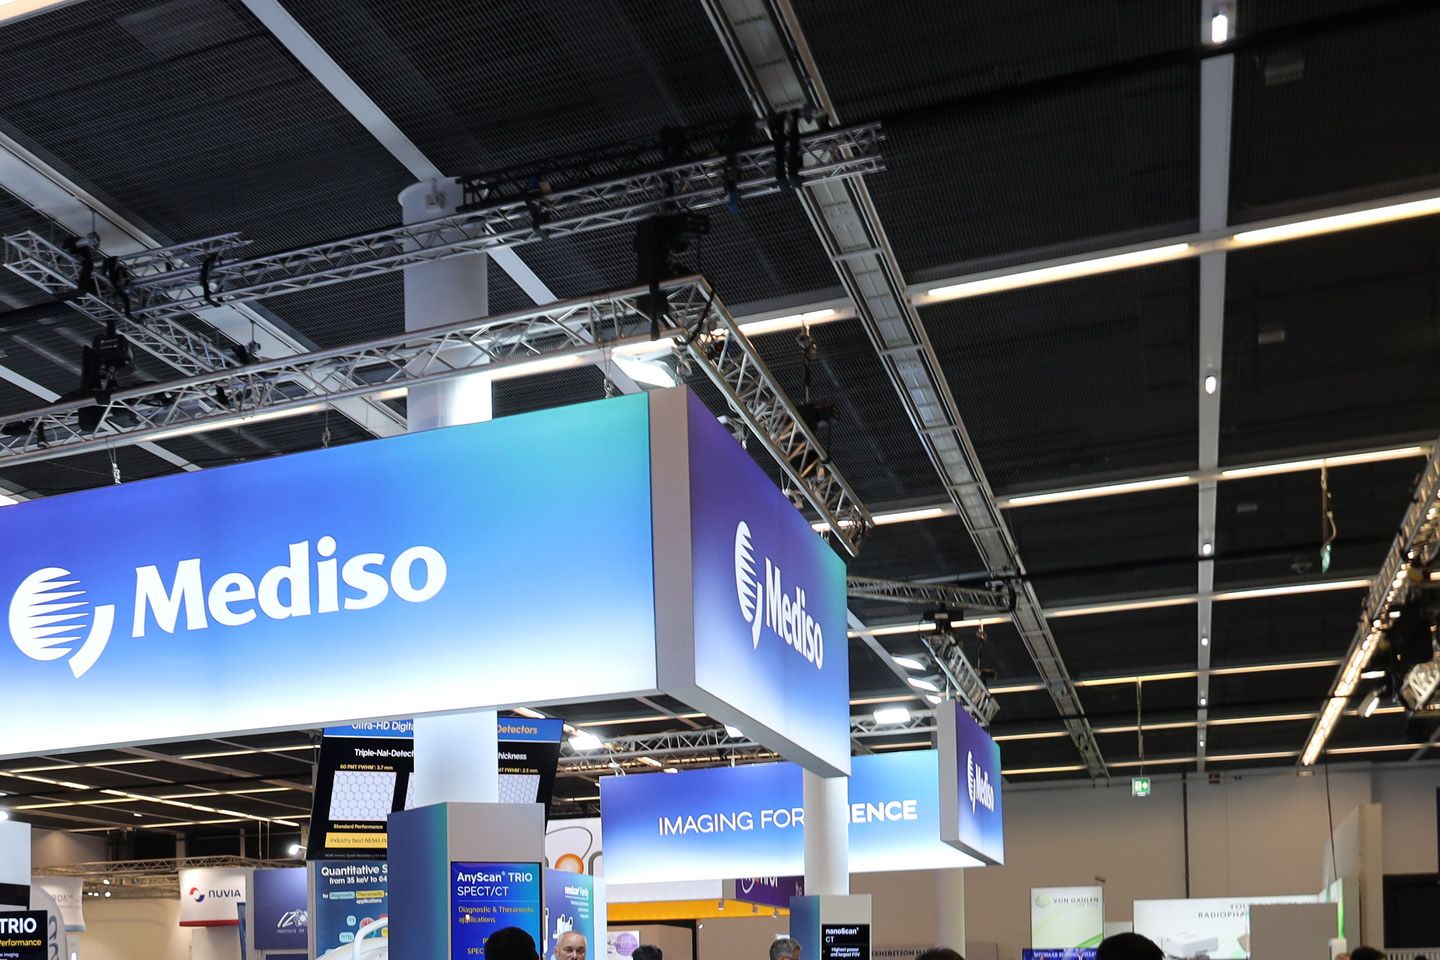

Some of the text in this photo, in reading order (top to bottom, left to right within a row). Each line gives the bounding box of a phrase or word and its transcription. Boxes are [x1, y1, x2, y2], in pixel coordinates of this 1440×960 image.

[131, 535, 448, 640] Mediso
[765, 556, 824, 671] Mediso
[975, 763, 995, 813] Mediso
[658, 799, 918, 837] IMAGING FOR IENCE
[321, 865, 380, 877] Quantitative
[329, 877, 345, 885] from
[508, 872, 533, 882] TRIO
[457, 886, 509, 896] SPECT/CT
[1053, 896, 1069, 904] VON
[458, 906, 491, 914] Diagnostic
[458, 916, 496, 924] applications
